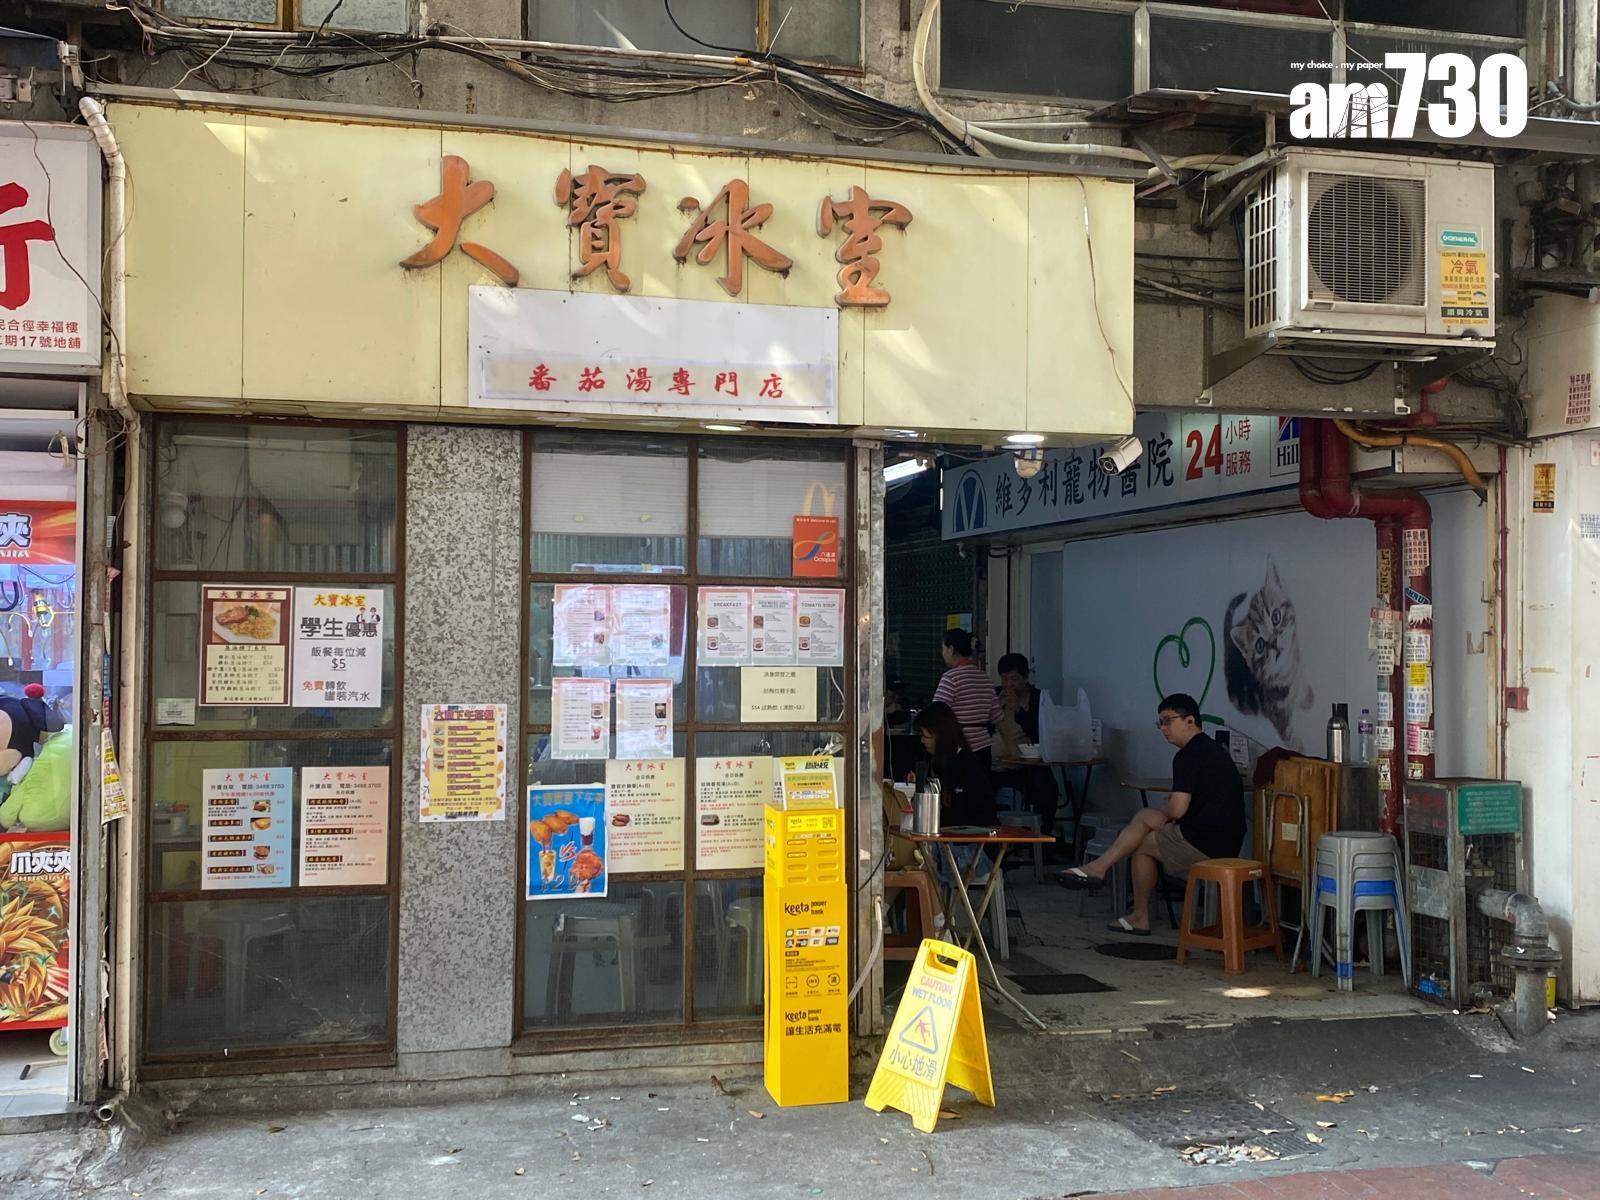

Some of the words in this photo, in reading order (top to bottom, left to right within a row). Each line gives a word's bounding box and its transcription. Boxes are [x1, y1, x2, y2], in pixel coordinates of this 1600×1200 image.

[399, 154, 914, 307] 大寶冰室
[1450, 259, 1478, 275] 冷氣
[0, 335, 81, 349] 期17號地舖
[528, 362, 784, 400] 番茄湯專門店
[1225, 416, 1252, 445] 小時
[1186, 424, 1224, 481] 24
[1225, 449, 1252, 478] 服務
[300, 616, 378, 638] 學生優惠
[311, 646, 367, 658] 飯餐每位減
[331, 658, 346, 670] $5
[784, 902, 810, 916] keeta
[911, 987, 928, 1001] WET
[920, 976, 954, 994] CAUTION
[785, 1010, 807, 1022] keeta
[889, 1044, 938, 1081] 小心地滑
